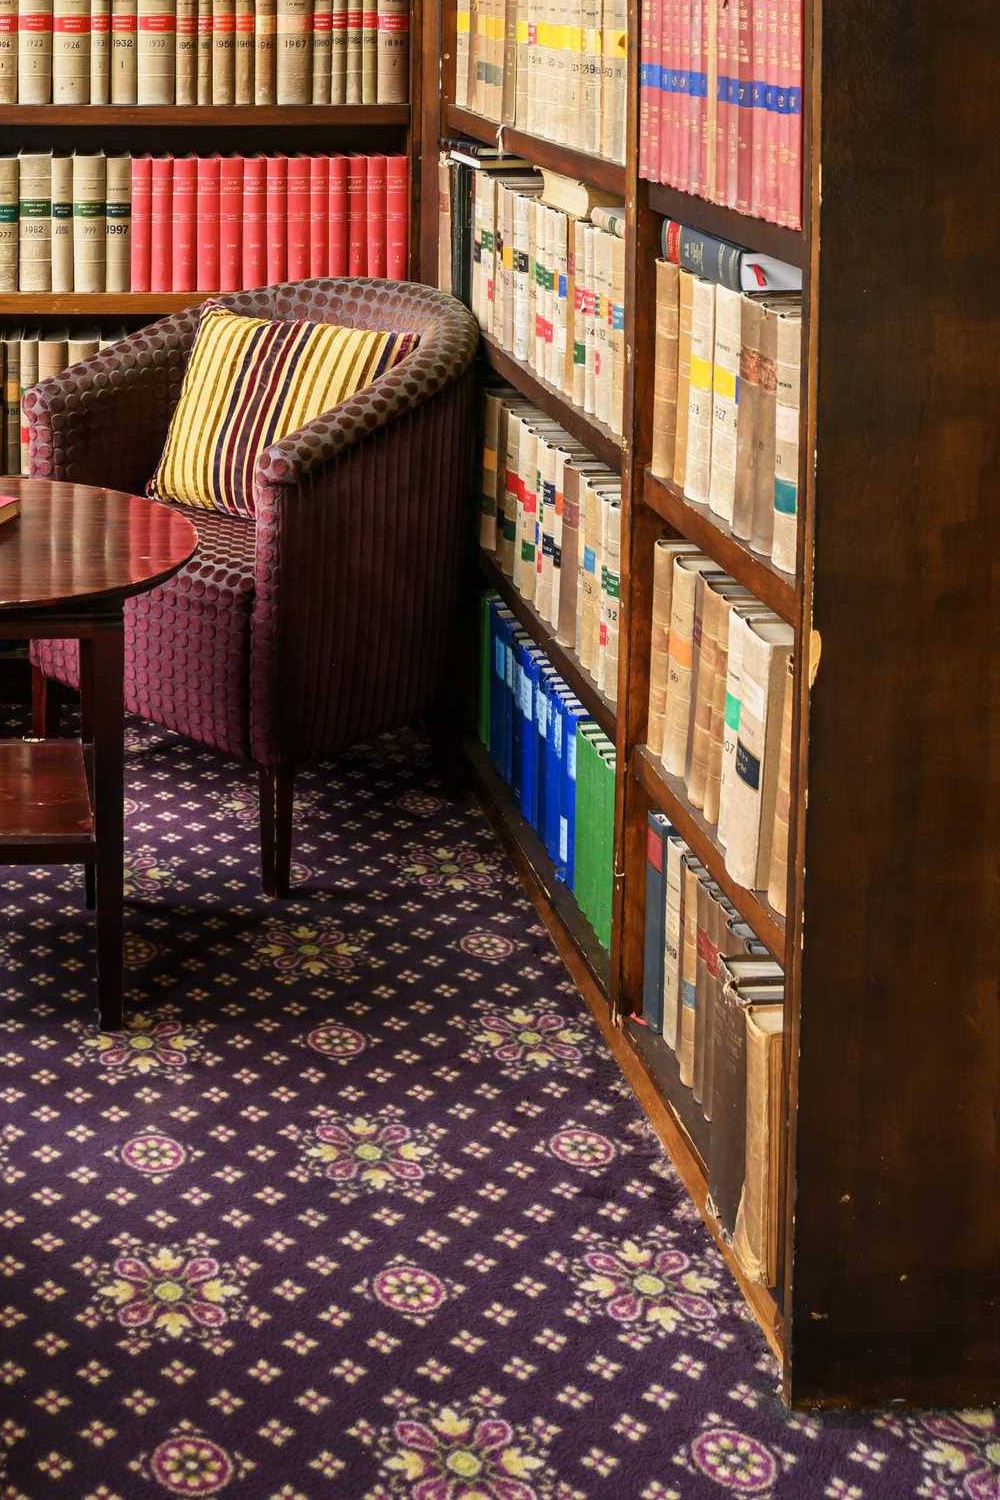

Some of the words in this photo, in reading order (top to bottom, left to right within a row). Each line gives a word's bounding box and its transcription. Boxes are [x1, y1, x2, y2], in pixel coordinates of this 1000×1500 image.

[26, 39, 44, 48] 1922
[63, 41, 80, 49] 1926
[113, 39, 133, 48] 1932
[149, 39, 165, 48] 1933
[178, 42, 197, 50] 1954
[215, 40, 235, 48] 1959
[285, 40, 307, 49] 1967
[314, 40, 331, 48] 1980
[32, 61, 38, 69] 2
[392, 59, 398, 67] 2
[25, 225, 43, 233] 1982
[107, 224, 130, 235] 1997
